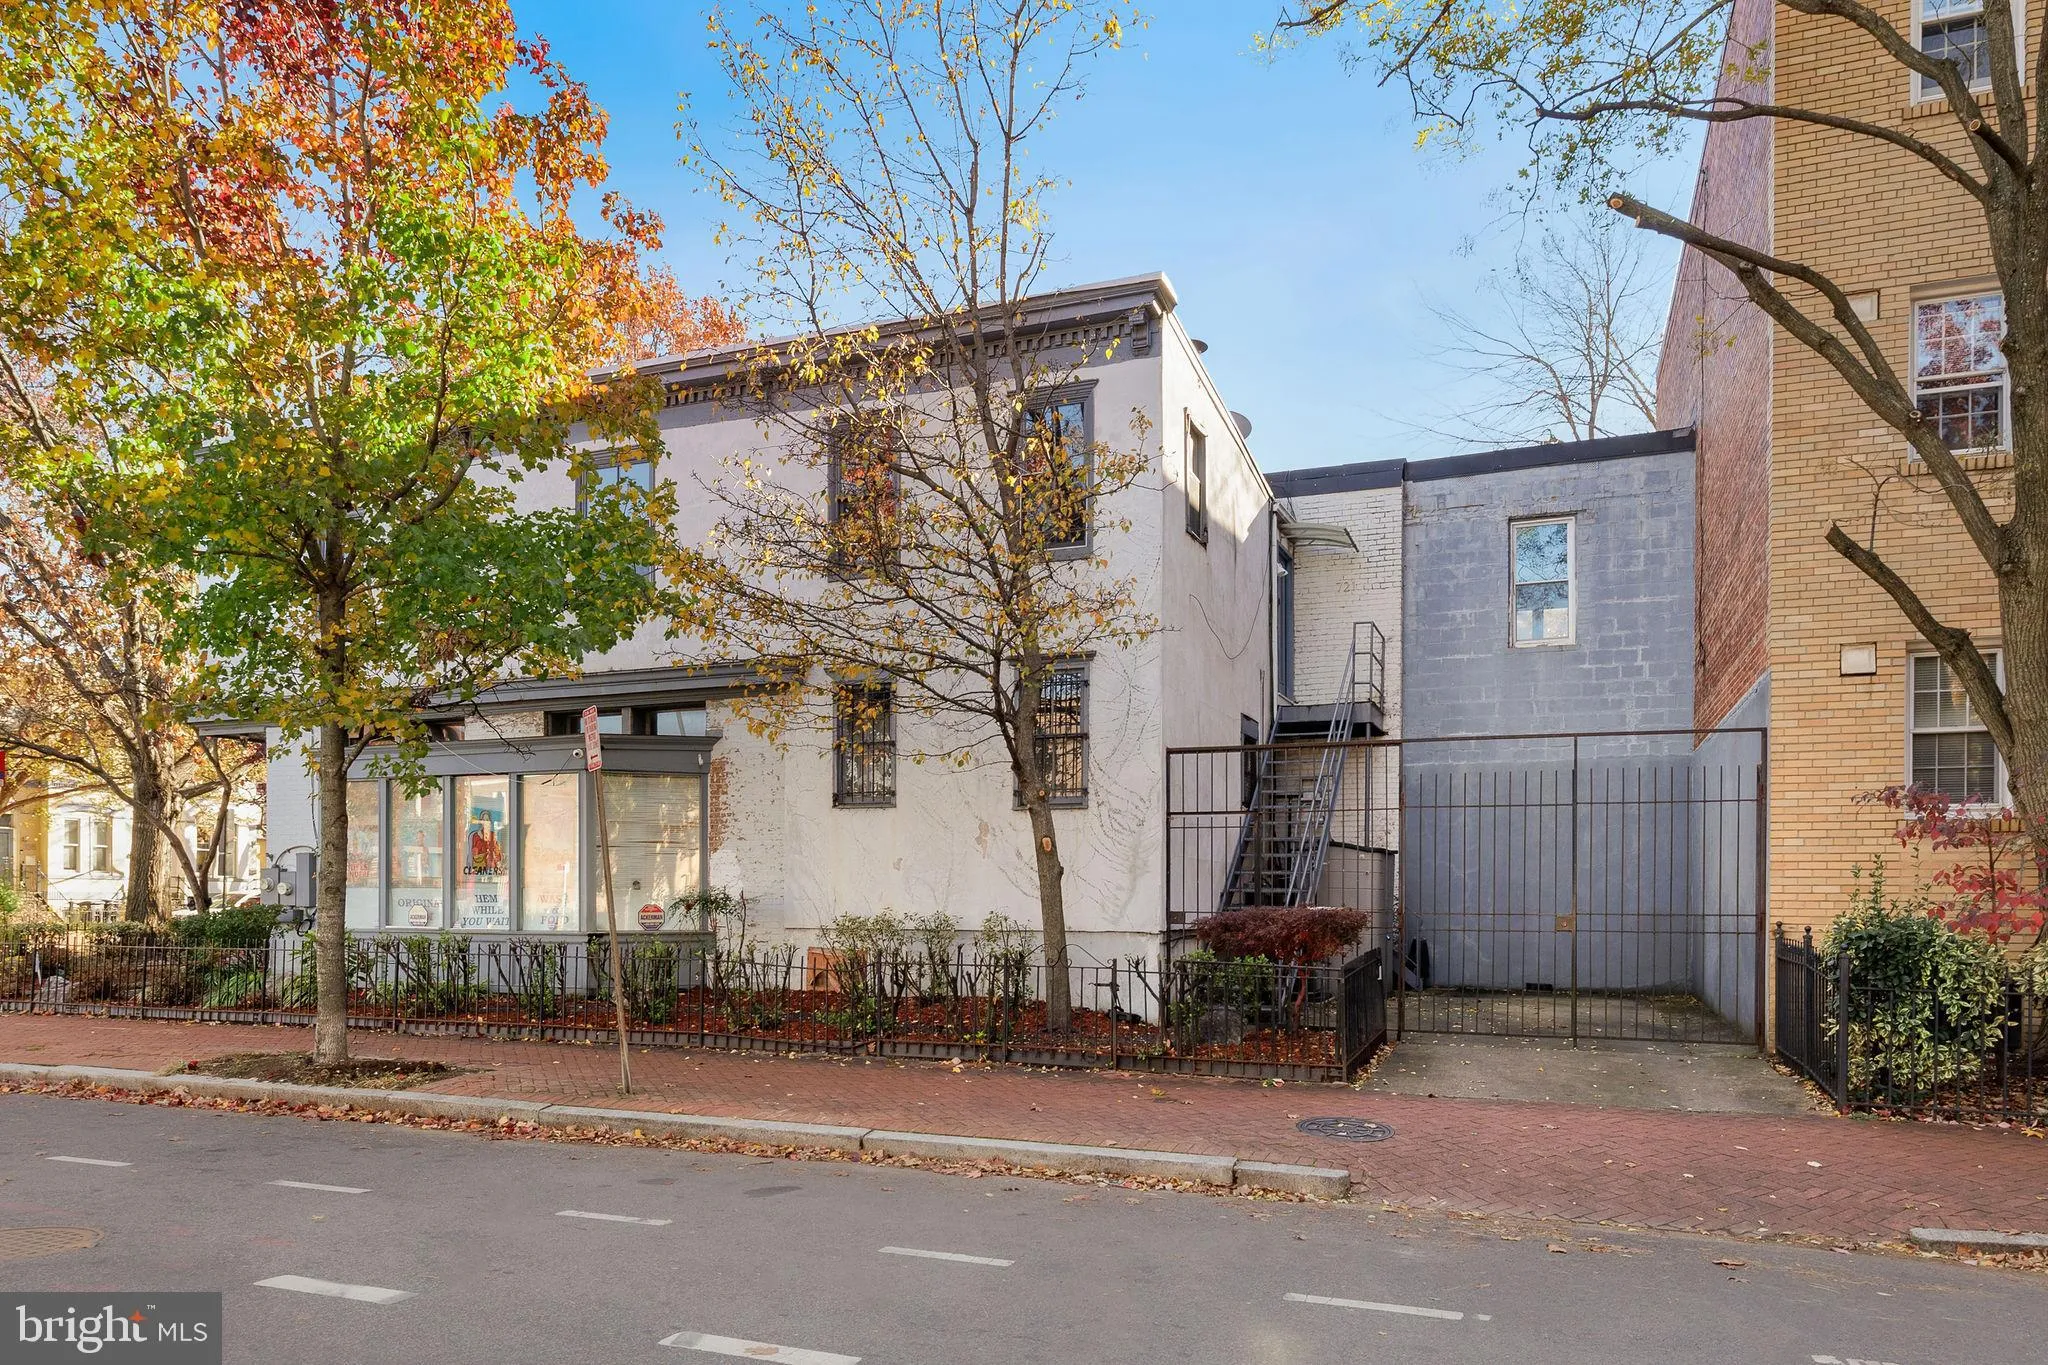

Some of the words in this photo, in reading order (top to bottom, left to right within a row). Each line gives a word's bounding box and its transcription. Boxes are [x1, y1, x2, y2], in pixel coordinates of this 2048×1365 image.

[463, 866, 503, 876] CLEANERS
[475, 894, 498, 903] HEM
[472, 906, 504, 915] WHILE
[463, 917, 484, 926] YOU
[486, 917, 510, 926] WAIT
